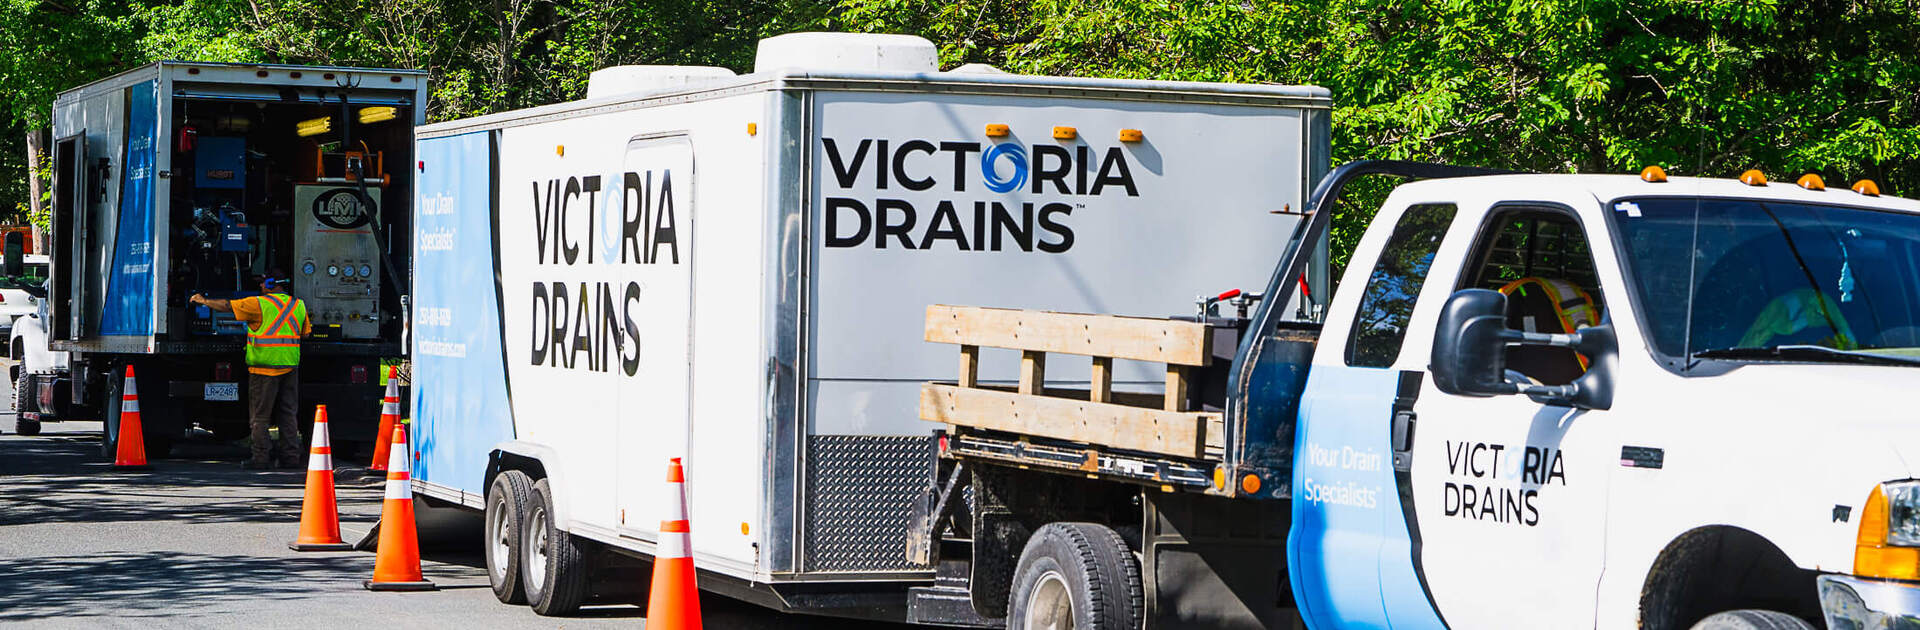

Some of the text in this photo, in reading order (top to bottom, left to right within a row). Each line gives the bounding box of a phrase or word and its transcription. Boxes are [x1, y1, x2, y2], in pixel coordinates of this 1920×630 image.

[821, 137, 1140, 197] VICTORIA
[421, 191, 454, 216] Your Drain
[532, 168, 680, 266] VICTORIA
[531, 280, 641, 377] DRAINS
[1308, 441, 1382, 472] Your Drain
[1446, 440, 1566, 486] VICTORIA
[1444, 482, 1539, 527] DRAINS
